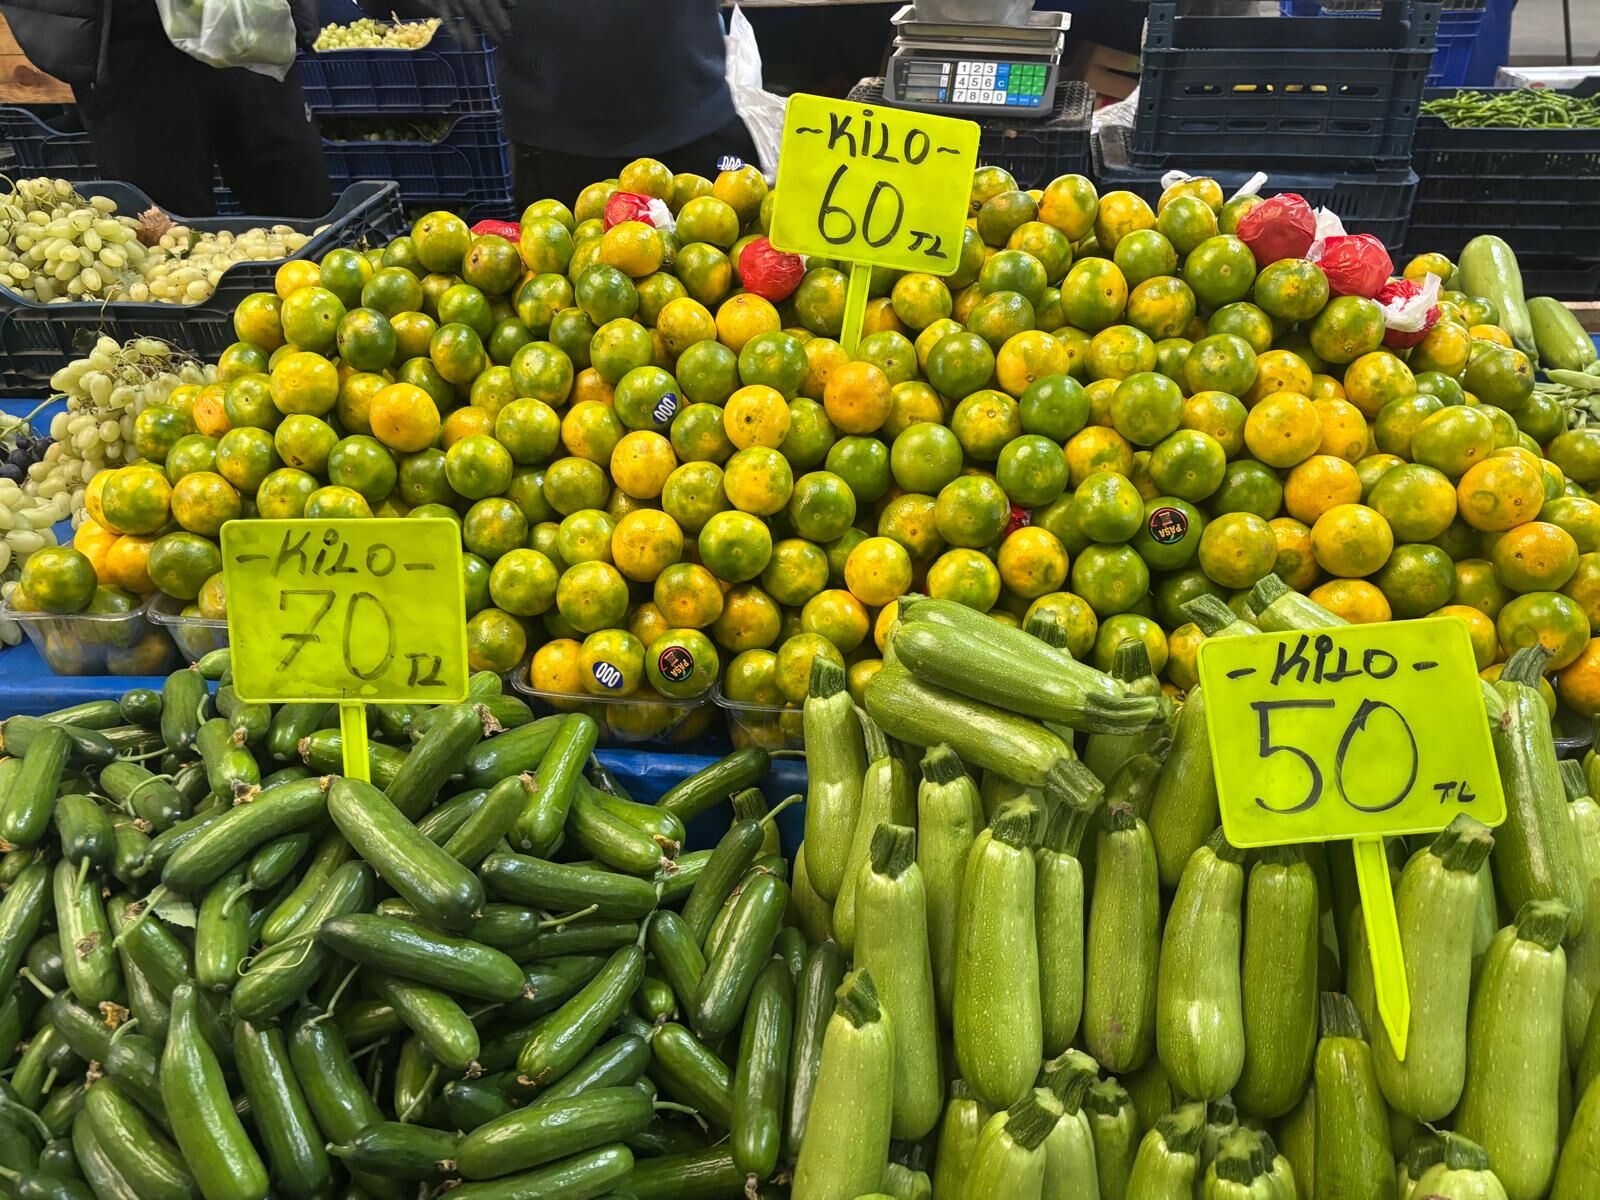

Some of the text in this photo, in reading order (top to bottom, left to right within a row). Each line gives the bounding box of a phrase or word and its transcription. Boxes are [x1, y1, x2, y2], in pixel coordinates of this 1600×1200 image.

[818, 164, 948, 259] 60 TL
[276, 590, 448, 687] 70 TL
[1250, 698, 1477, 814] 50 TL
